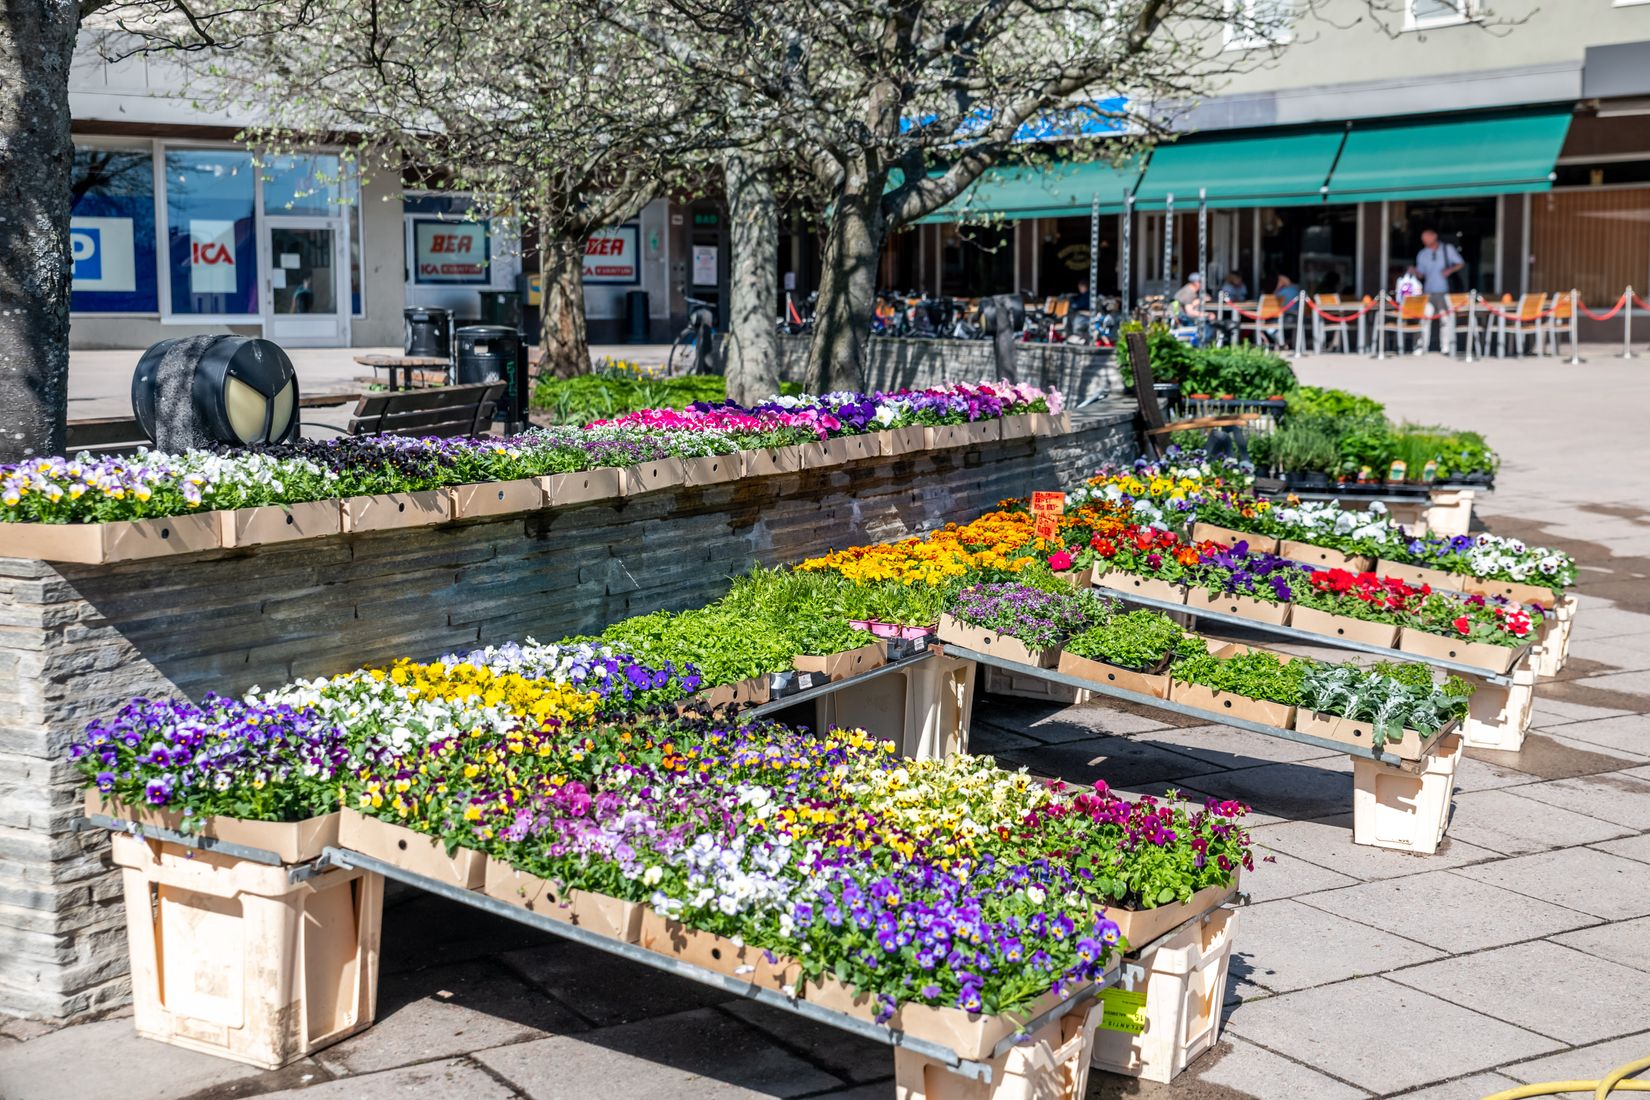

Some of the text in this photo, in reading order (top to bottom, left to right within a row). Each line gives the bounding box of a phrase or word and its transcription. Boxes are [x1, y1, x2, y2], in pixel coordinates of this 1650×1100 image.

[71, 232, 95, 275] P
[193, 243, 235, 265] ICA
[430, 235, 473, 254] BEA
[586, 238, 624, 256] BEA
[421, 263, 439, 275] ICA
